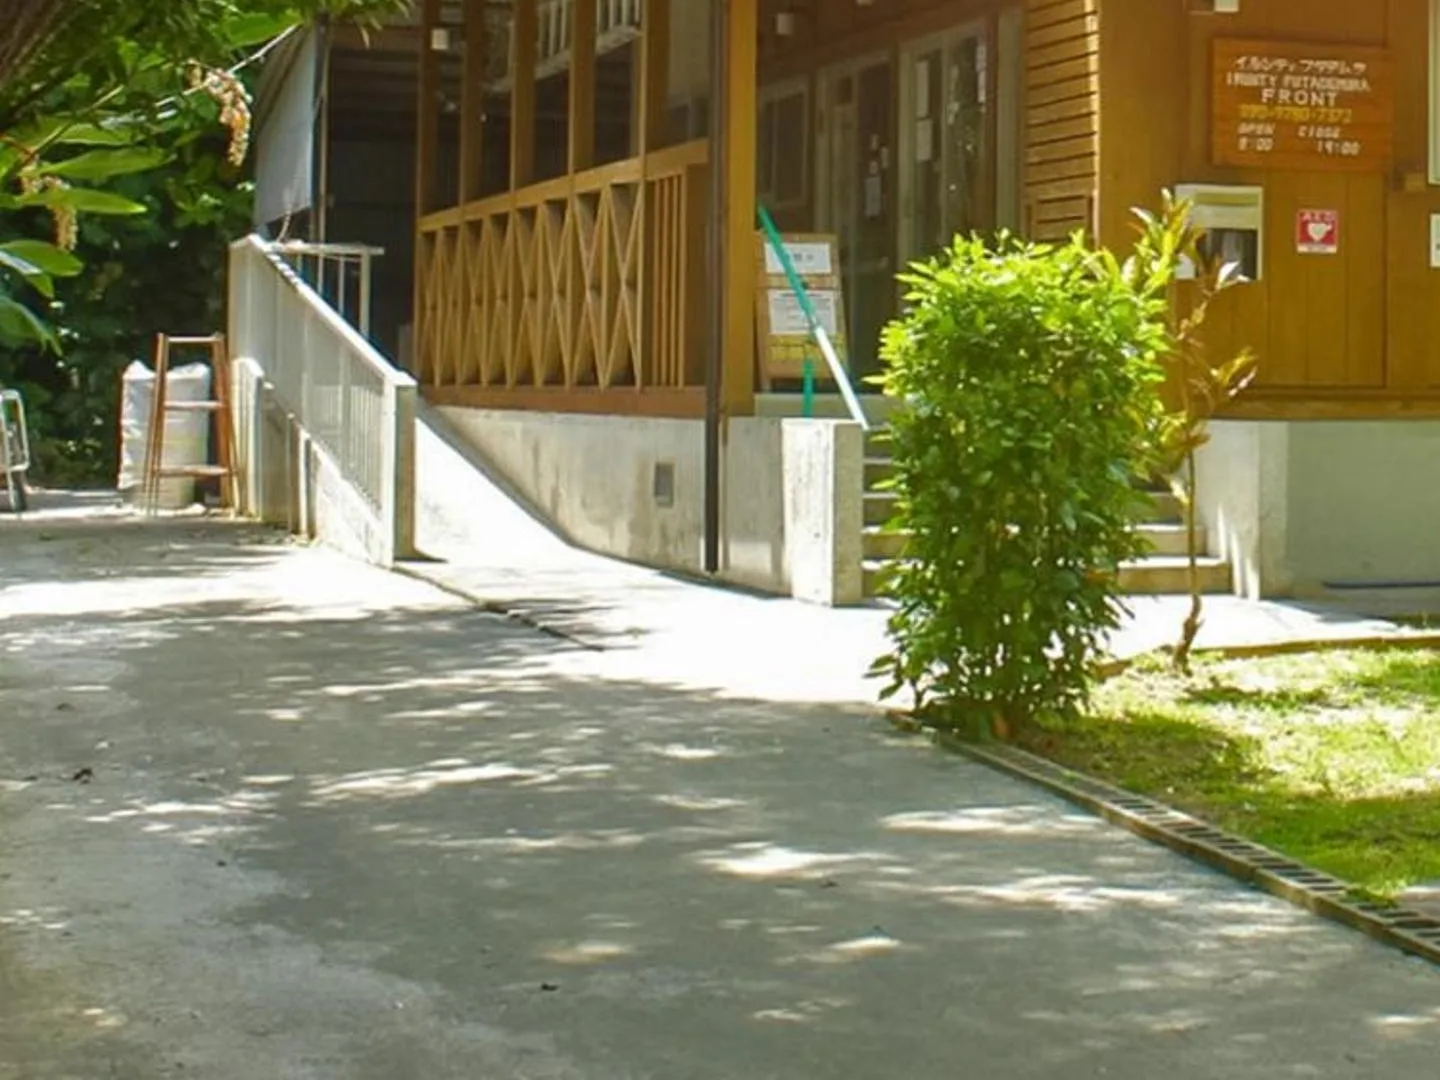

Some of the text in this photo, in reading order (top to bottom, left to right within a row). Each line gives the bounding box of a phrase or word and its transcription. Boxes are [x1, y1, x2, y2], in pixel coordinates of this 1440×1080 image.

[1261, 88, 1338, 107] FRONT
[1237, 122, 1341, 139] OPEN CLOSE
